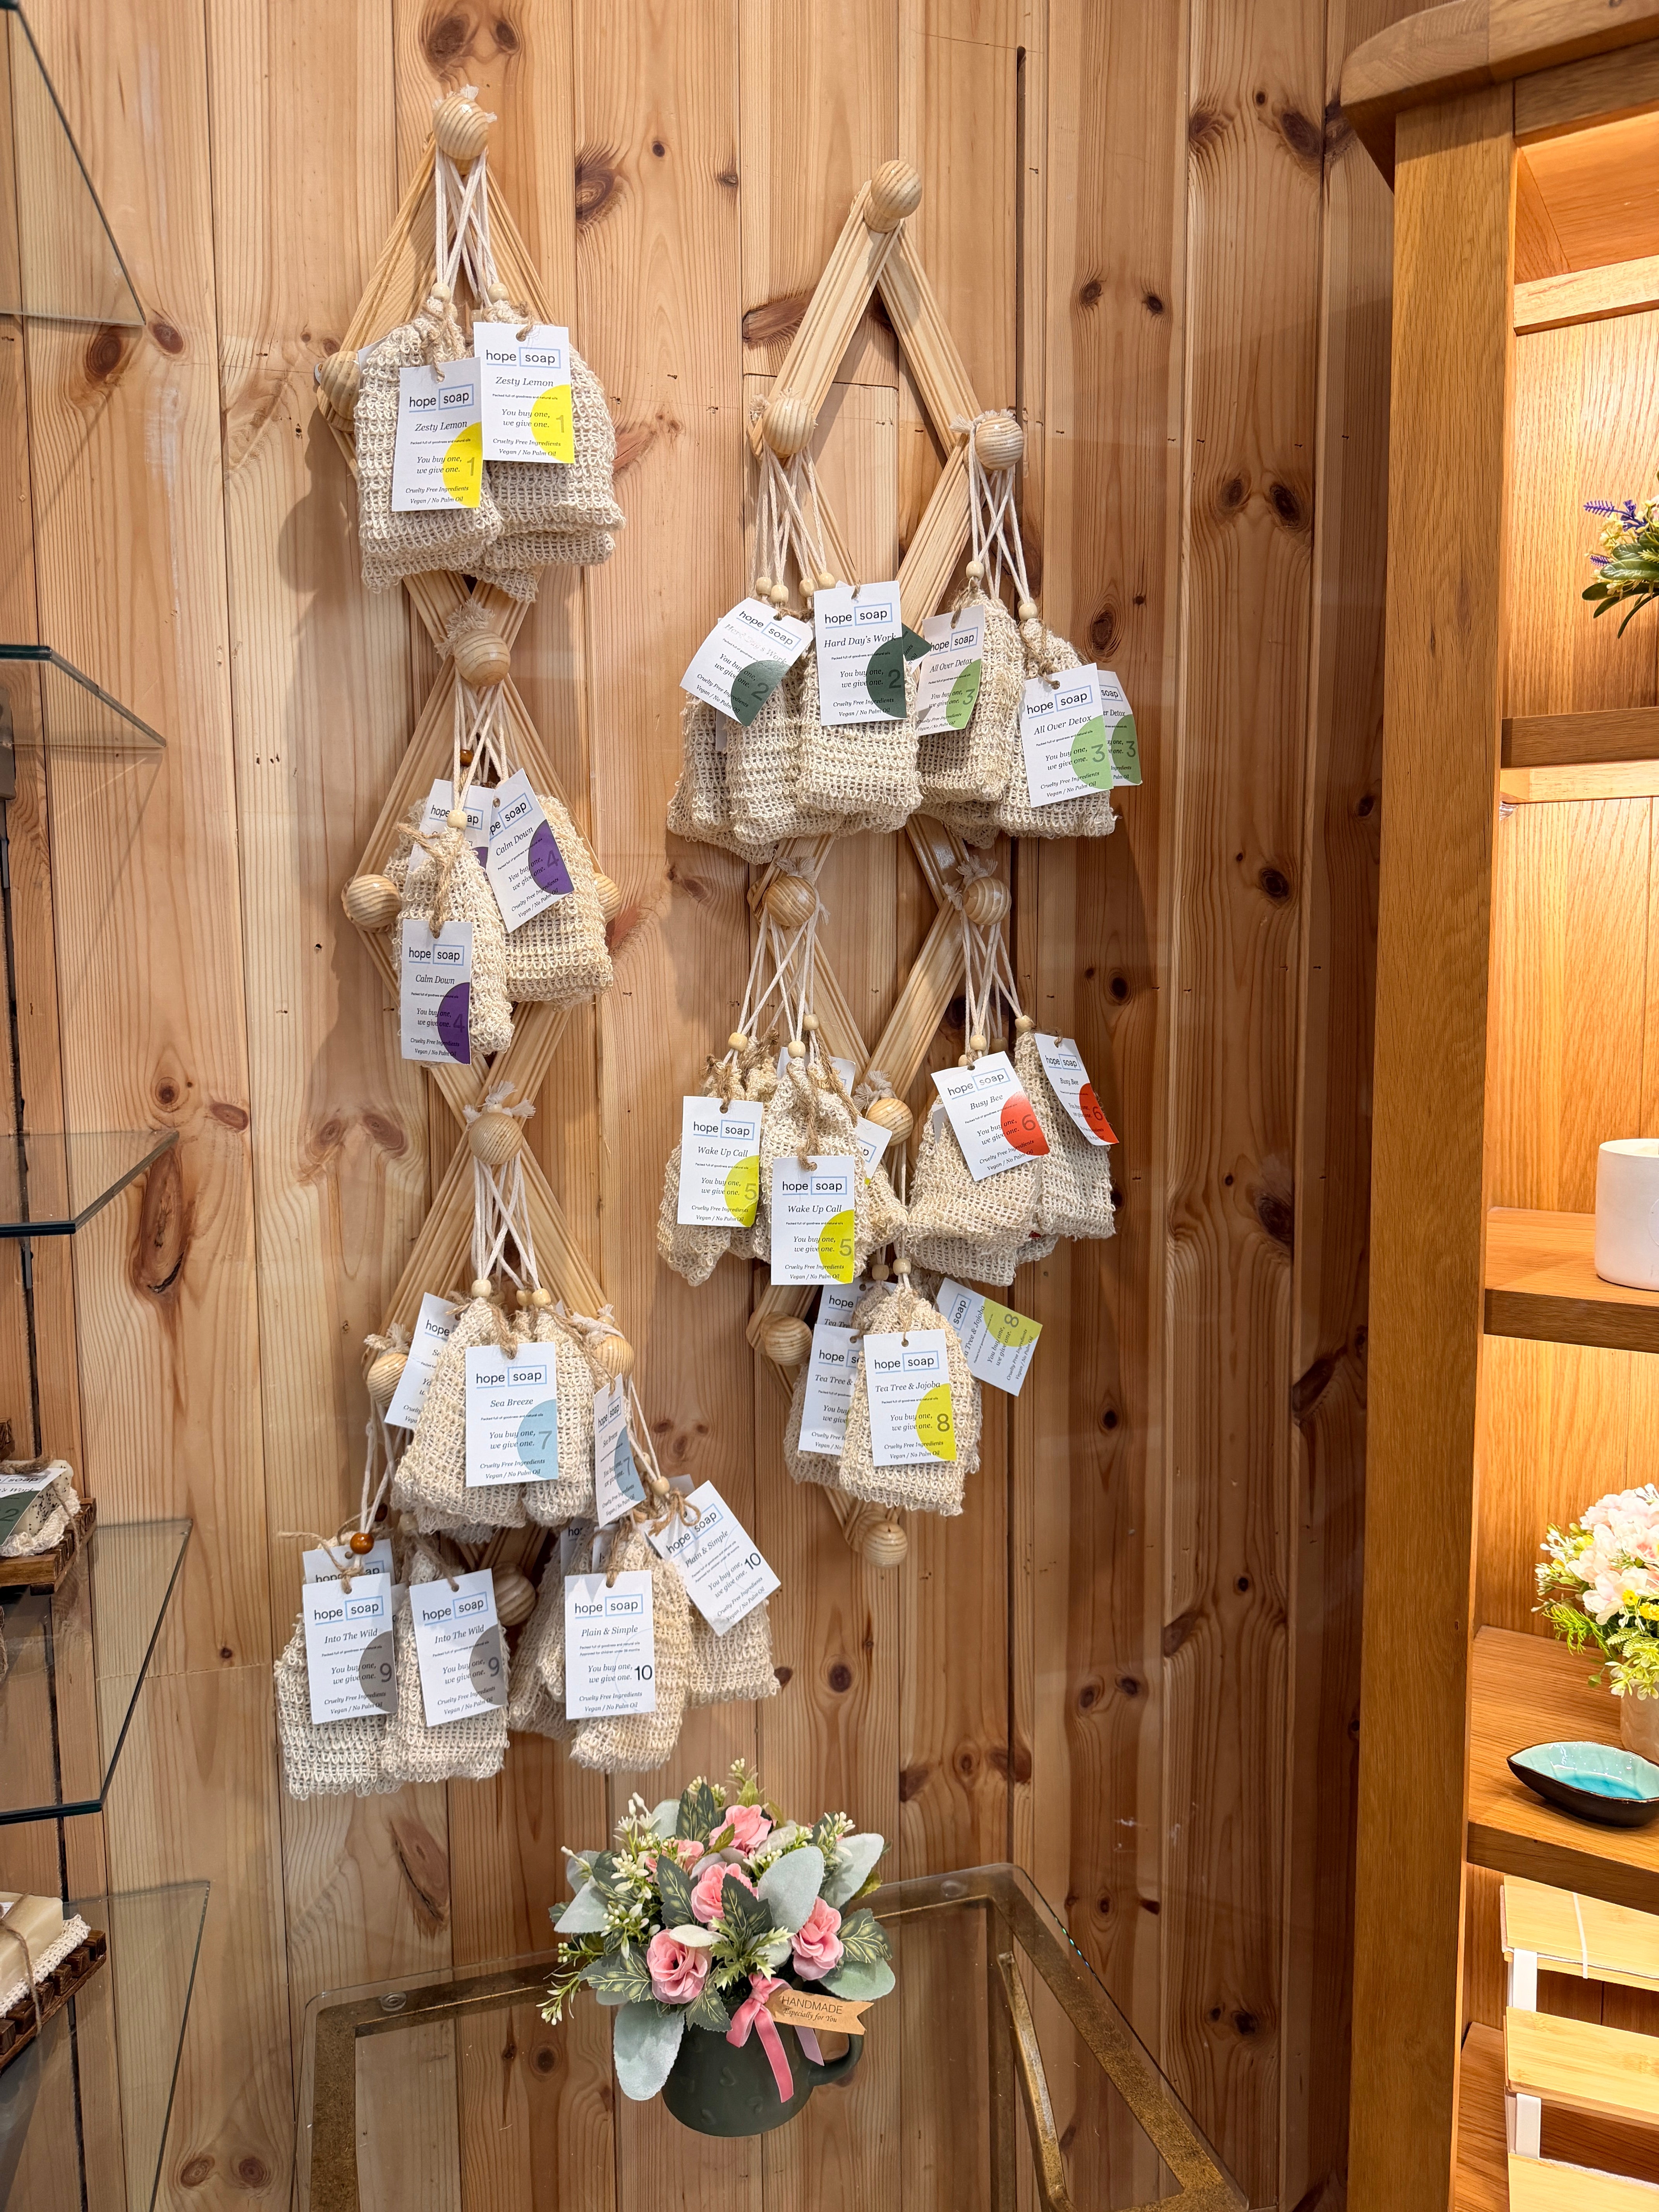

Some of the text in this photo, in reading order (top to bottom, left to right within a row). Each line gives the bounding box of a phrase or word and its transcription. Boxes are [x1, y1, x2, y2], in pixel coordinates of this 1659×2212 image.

[486, 350, 555, 365] hope soap
[495, 376, 553, 387] Zesty Lemon
[409, 392, 469, 408] hope soap
[518, 409, 532, 418] buy
[414, 421, 467, 433] Zesty Lemon
[556, 414, 565, 433] 1
[467, 457, 475, 476] 1
[824, 610, 887, 625] hope soap
[739, 611, 793, 645] hope soap
[824, 632, 896, 648] Hard Day's Work
[930, 635, 974, 652] hope soap
[929, 658, 973, 673] All Over Detox
[888, 669, 902, 689] 2
[751, 682, 768, 701] 2
[962, 689, 975, 705] 3
[1101, 689, 1118, 699] soap
[1027, 693, 1087, 714] hope soap
[1034, 715, 1092, 735] All Over Detox
[1091, 744, 1106, 763] 3
[1126, 741, 1136, 757] 3
[505, 802, 526, 822] soap
[496, 827, 533, 856] Calm Down
[546, 850, 560, 868] 4
[409, 947, 460, 962] hope soap
[416, 974, 455, 984] Calm Down
[453, 1013, 465, 1033] 4
[1045, 1055, 1077, 1068] hope soap
[947, 1074, 1004, 1096] hope soap
[1060, 1078, 1070, 1086] Busy
[970, 1095, 1003, 1110] Busy Bee
[1092, 1106, 1103, 1121] 6
[694, 1121, 750, 1137] hope soap
[1022, 1114, 1036, 1131] 6
[698, 1146, 718, 1155] Wake
[720, 1148, 731, 1158] Up
[744, 1183, 757, 1200] 5
[782, 1181, 842, 1193] hope soap
[812, 1205, 824, 1214] Up
[826, 1204, 842, 1212] Call
[839, 1238, 852, 1256] 5
[828, 1295, 854, 1309] hope
[953, 1300, 967, 1324] soap
[426, 1319, 450, 1336] hope
[965, 1334, 974, 1350] Tree
[974, 1305, 985, 1328] Jojoba
[1004, 1314, 1019, 1328] 8
[819, 1349, 845, 1363] hope
[874, 1358, 934, 1370] hope soap
[476, 1372, 542, 1385] hope soap
[830, 1376, 846, 1385] Tree
[915, 1381, 940, 1391] Jojoba
[598, 1404, 620, 1428] hope soap
[936, 1413, 950, 1432] 8
[539, 1431, 553, 1449] 7
[623, 1456, 630, 1476] 7
[666, 1512, 717, 1554] hope soap
[685, 1551, 702, 1568] Plain
[708, 1530, 728, 1550] Simple
[744, 1552, 761, 1571] 10
[314, 1603, 379, 1620] hope soap
[422, 1600, 484, 1621] hope soap
[575, 1601, 638, 1614] hope soap
[324, 1628, 378, 1644] Into The Wild
[434, 1624, 484, 1644] Into The Wild
[581, 1628, 601, 1637] Plain
[611, 1625, 638, 1635] Simple
[380, 1663, 392, 1682] 9
[488, 1657, 500, 1677] 9
[635, 1665, 653, 1681] 10
[781, 1996, 843, 2014] HANDMADE
[783, 2008, 813, 2020] Especially
